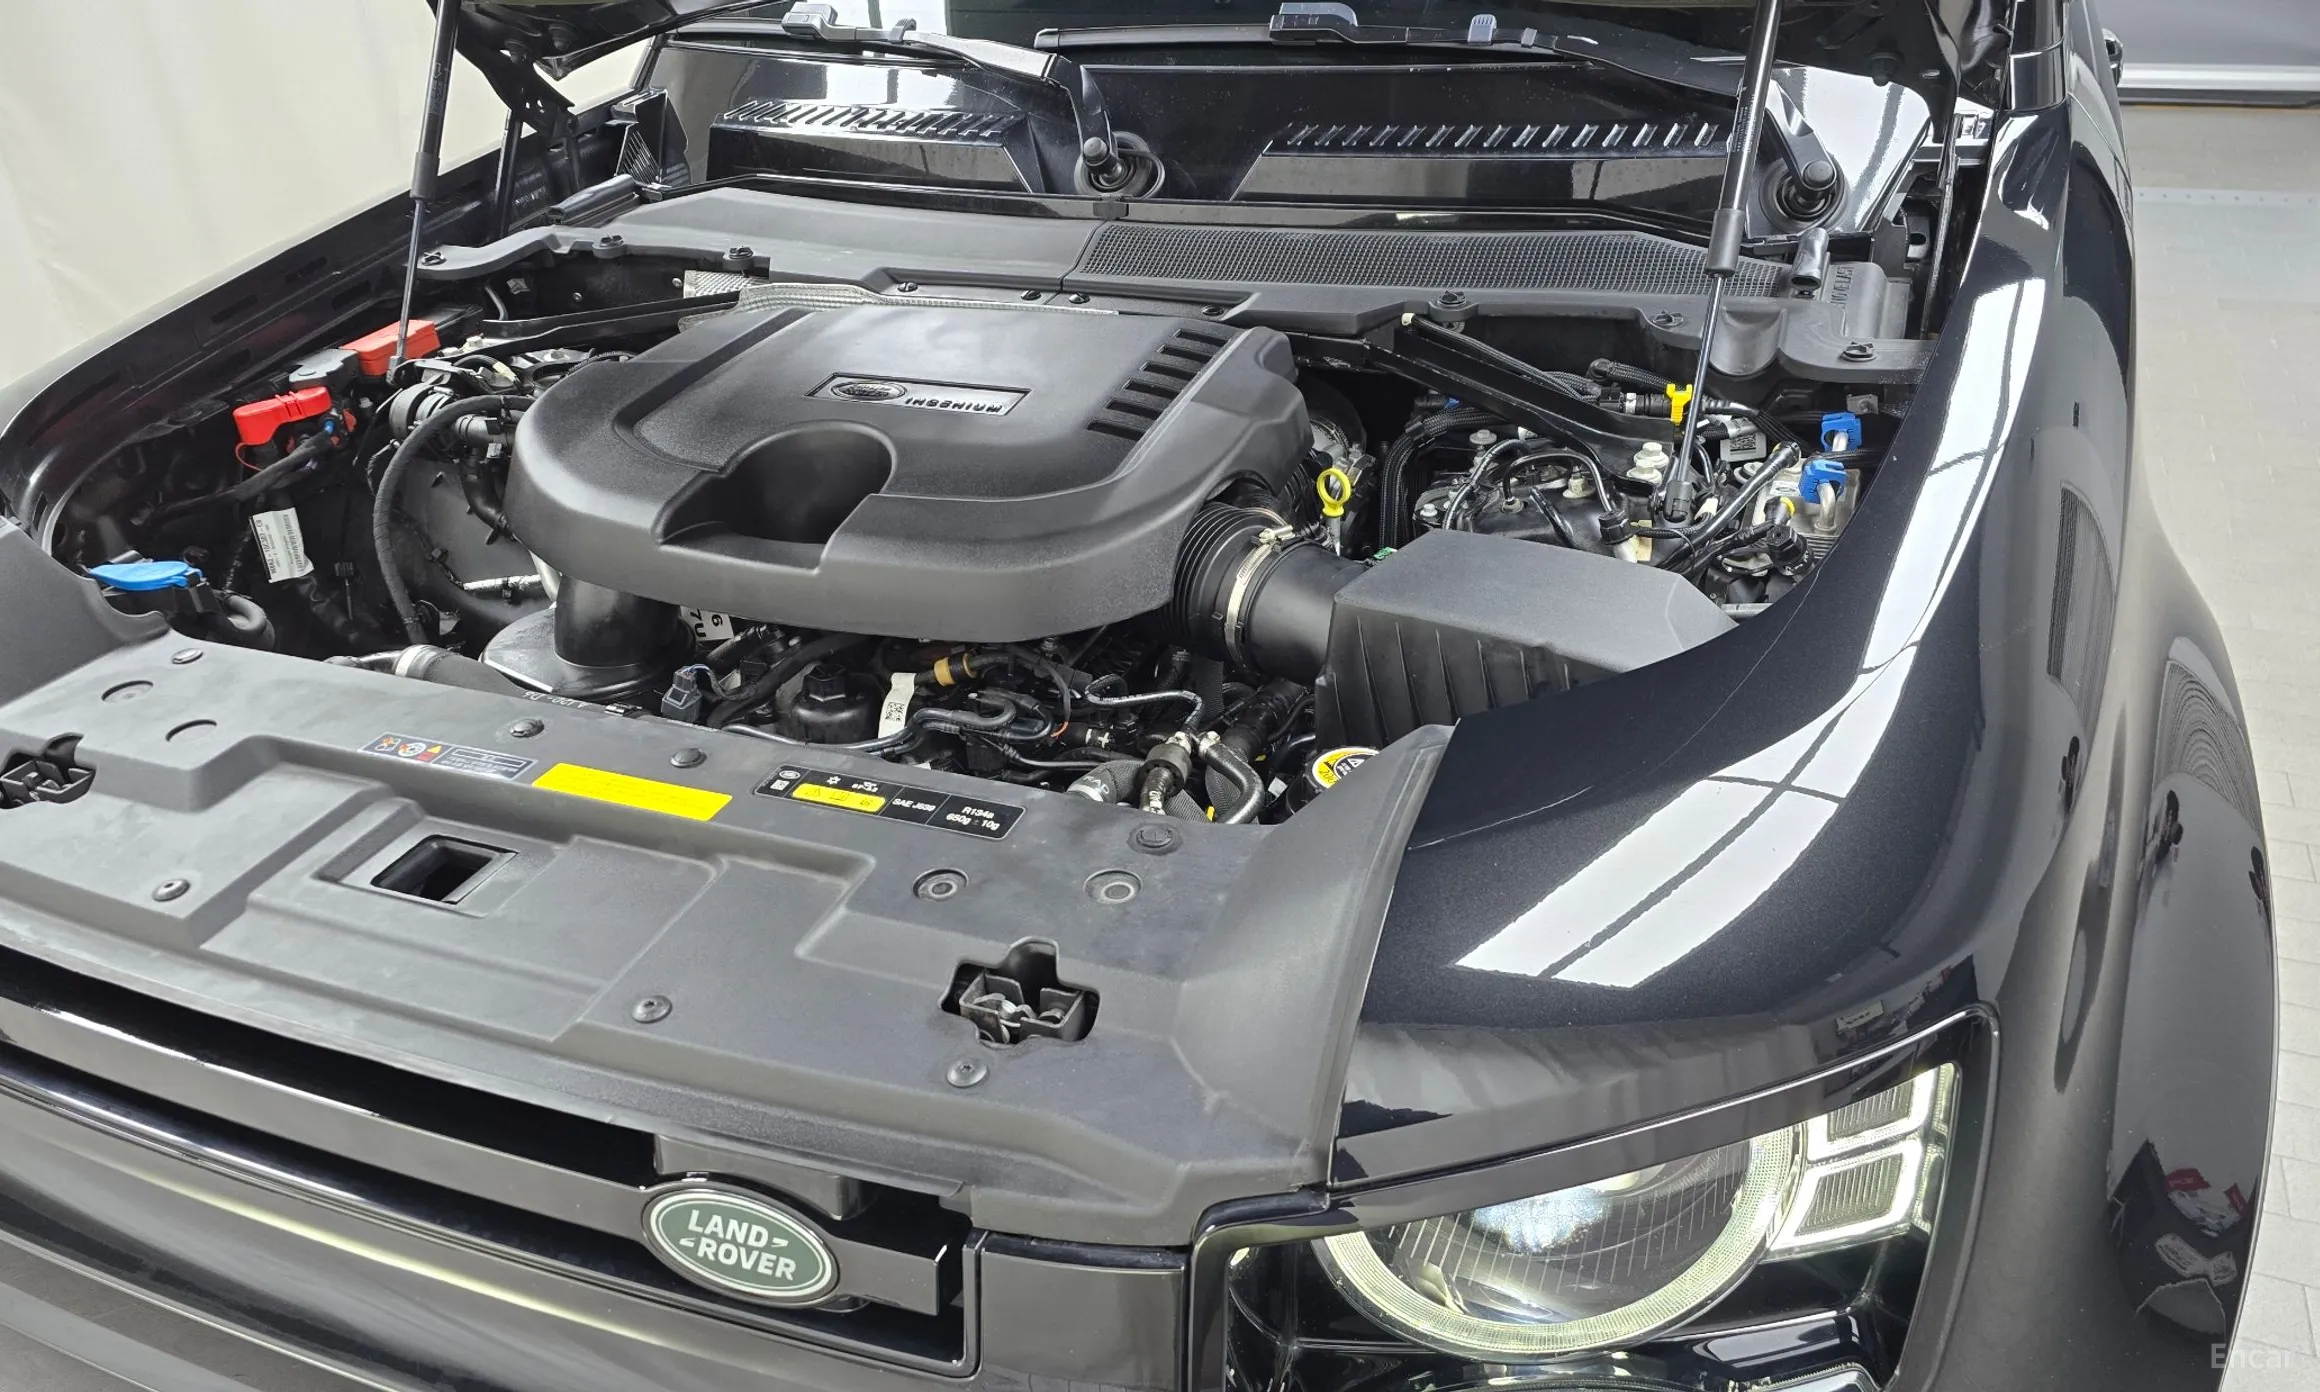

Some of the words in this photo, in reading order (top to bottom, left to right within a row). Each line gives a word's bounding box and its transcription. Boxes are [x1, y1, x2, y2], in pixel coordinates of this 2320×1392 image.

[892, 798, 912, 808] SAE
[961, 806, 995, 819] R134a
[981, 819, 1001, 831] 10g
[688, 1209, 769, 1248] LAND
[697, 1237, 797, 1281] ROVER
